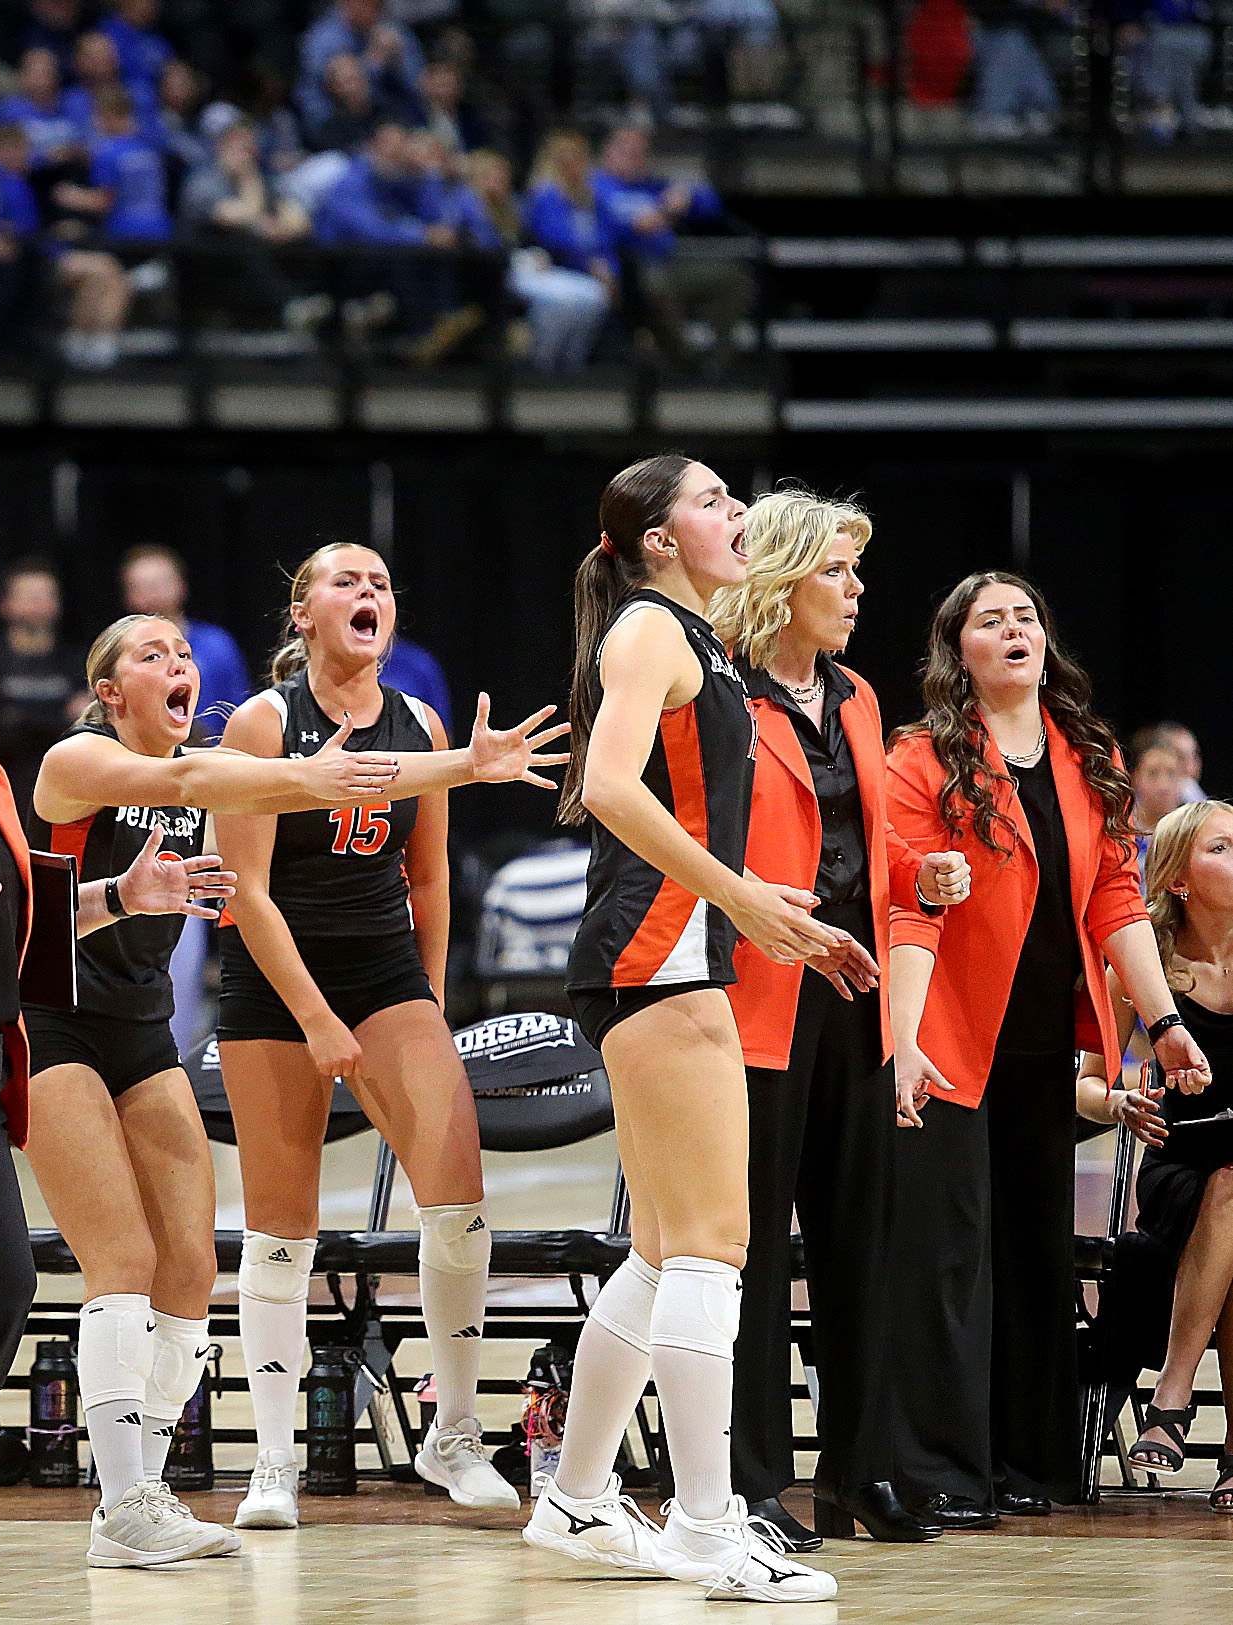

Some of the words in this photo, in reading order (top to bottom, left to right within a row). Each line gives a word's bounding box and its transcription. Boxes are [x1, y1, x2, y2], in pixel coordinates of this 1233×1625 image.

[329, 801, 391, 855] 15
[453, 1014, 561, 1055] DHSAA
[541, 1083, 592, 1097] HEALTH
